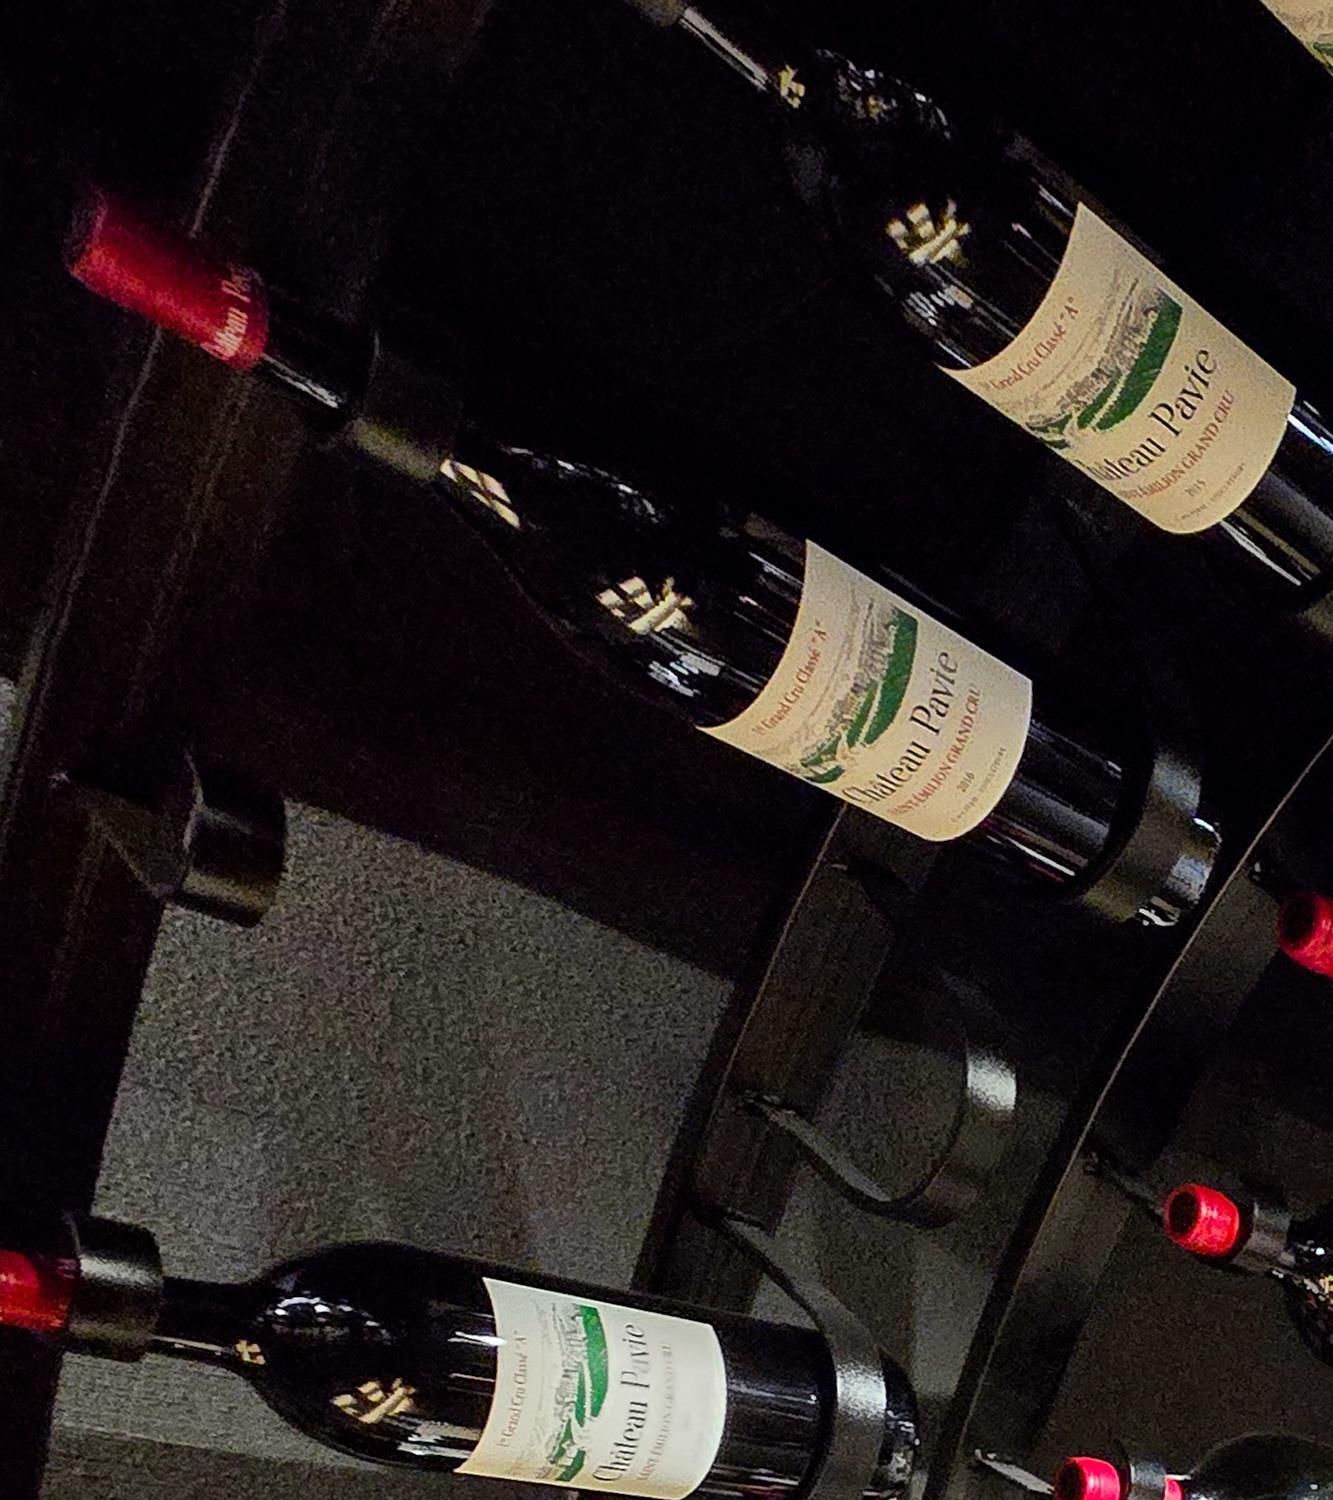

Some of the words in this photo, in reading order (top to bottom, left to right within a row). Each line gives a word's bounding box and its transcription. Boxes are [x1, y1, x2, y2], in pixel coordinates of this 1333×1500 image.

[1148, 348, 1219, 438] Pavie
[1182, 413, 1222, 472] GRAND
[1214, 390, 1234, 427] CRU
[785, 684, 801, 708] Cru
[842, 739, 930, 803] Château
[910, 651, 958, 736] Pavie
[949, 715, 974, 767] GRAND
[967, 688, 981, 717] CRU
[620, 1324, 651, 1389] Pavie
[592, 1401, 649, 1482] Château
